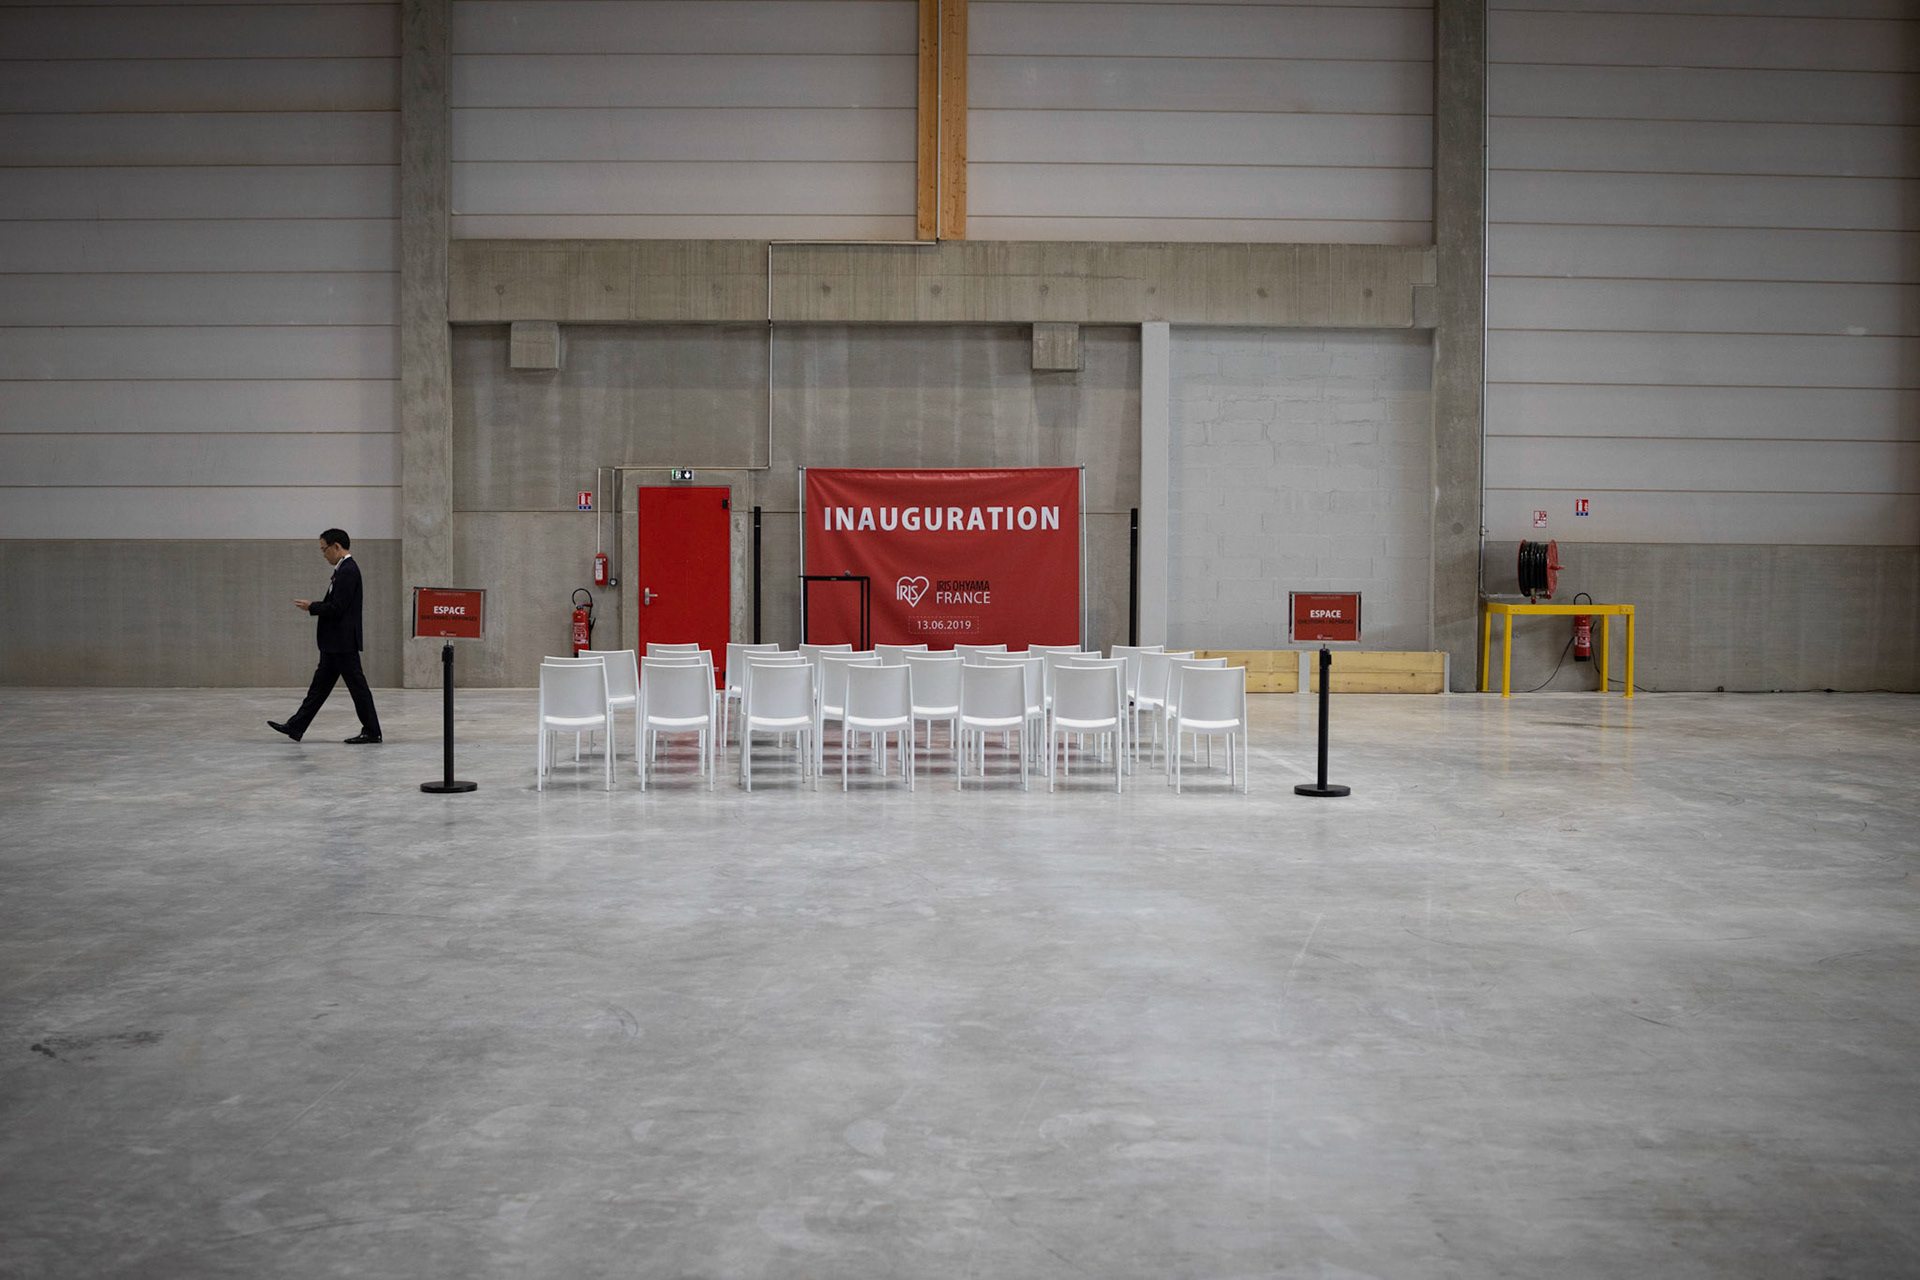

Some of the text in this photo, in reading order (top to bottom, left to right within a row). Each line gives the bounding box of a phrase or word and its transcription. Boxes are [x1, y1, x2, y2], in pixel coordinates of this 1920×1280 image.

[824, 506, 1060, 531] INAUGURATION
[936, 580, 990, 592] IRIS OHYAMA
[936, 591, 991, 604] FRANCE
[433, 606, 466, 615] ESPACE
[1310, 609, 1342, 618] ESPACE
[917, 620, 972, 630] 13.06.2019
